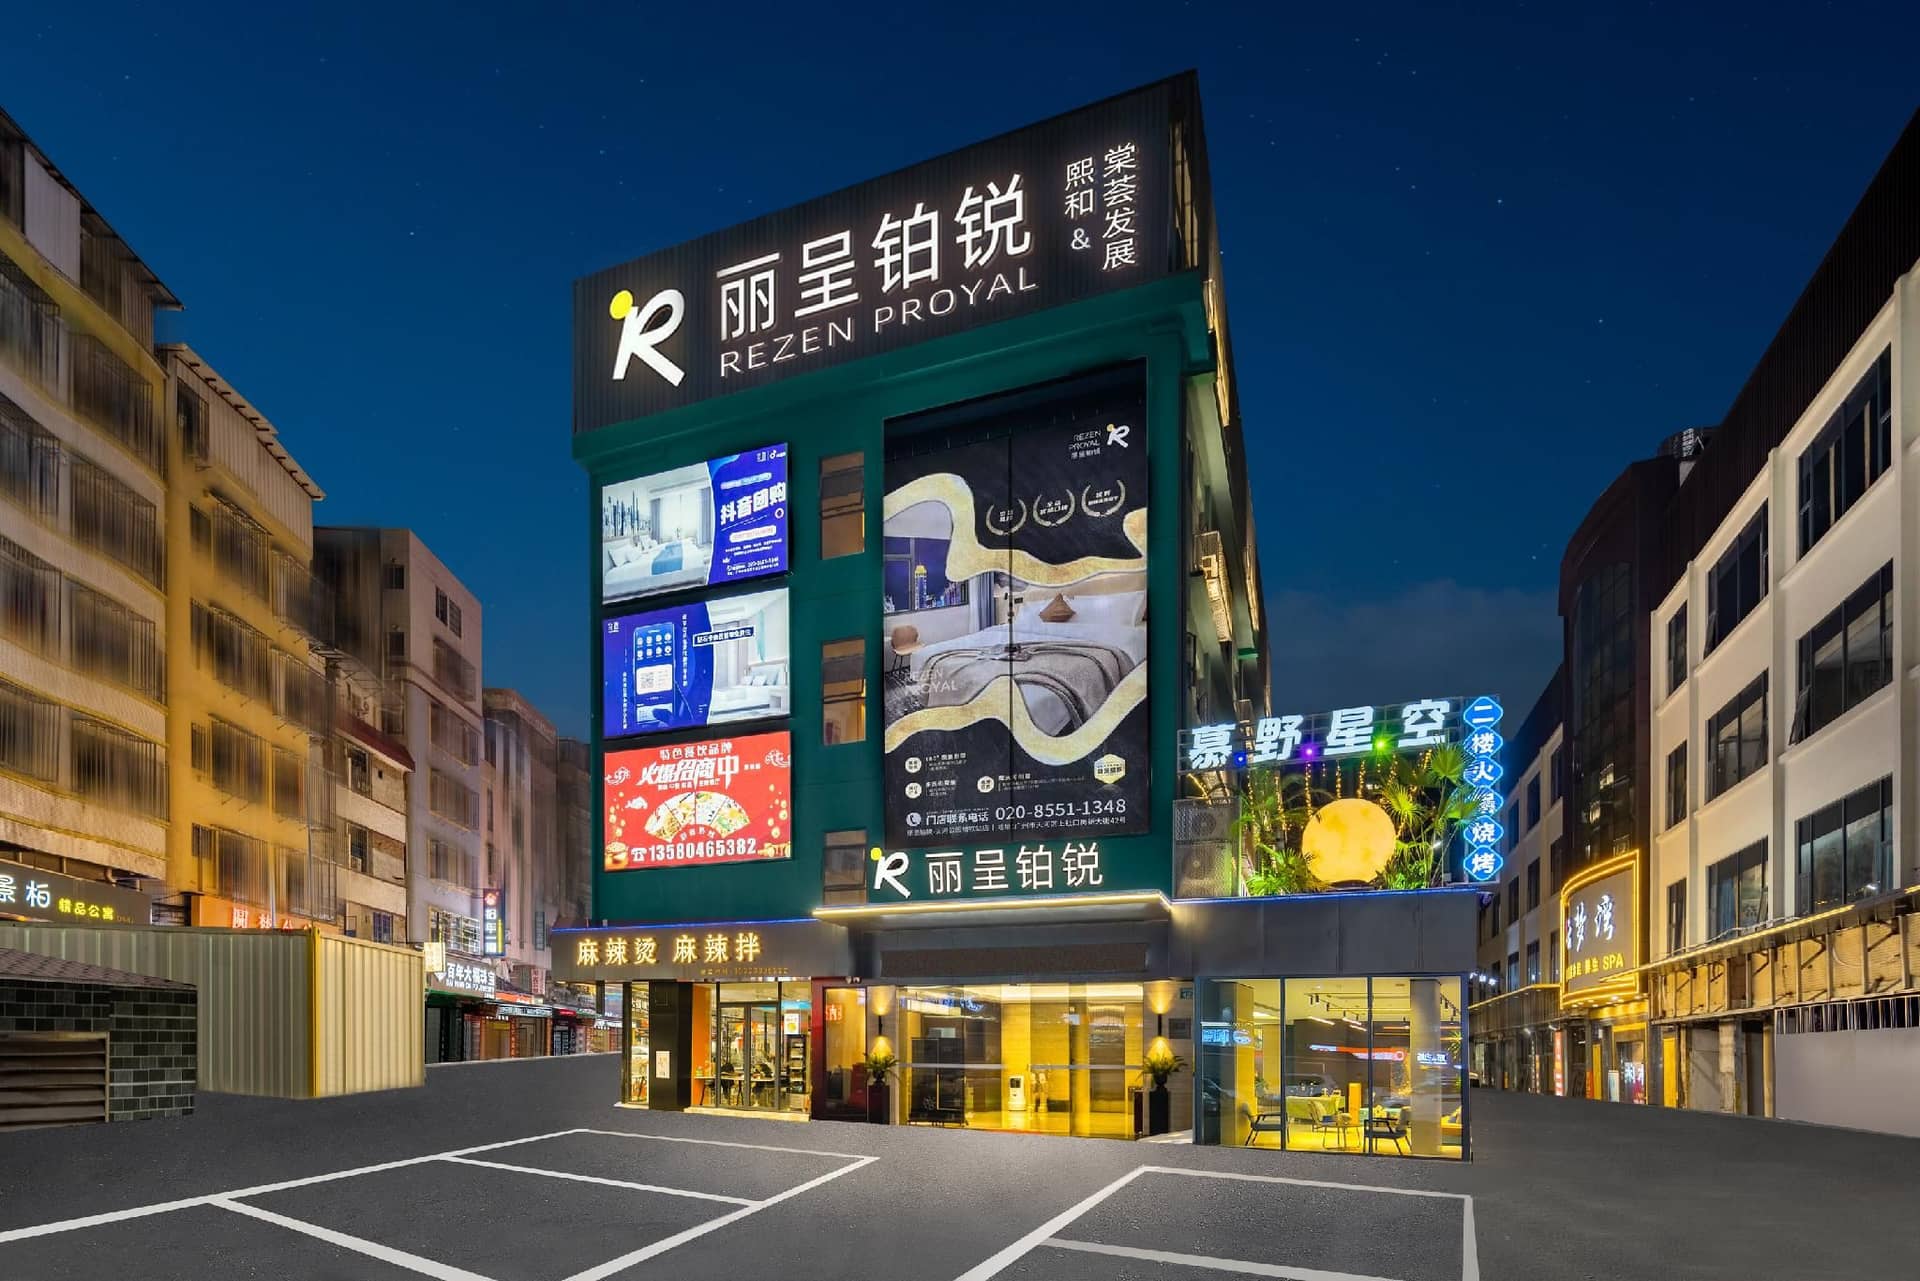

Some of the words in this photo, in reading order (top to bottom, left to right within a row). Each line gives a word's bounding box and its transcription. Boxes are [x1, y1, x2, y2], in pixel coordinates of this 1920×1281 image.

[1102, 142, 1136, 271] 棠荟发展
[716, 173, 1034, 342] 丽呈铂锐
[719, 317, 854, 377] REZEN
[873, 267, 1038, 333] PROYAL
[1073, 430, 1101, 442] REZEN
[926, 811, 989, 826] 门店联系电话
[995, 798, 1127, 821] 020-8551-1348
[649, 837, 757, 862] 13580465382
[925, 842, 1103, 894] 丽呈铂锐
[576, 936, 657, 967] 麻辣烫
[672, 931, 762, 964] 麻辣拌
[1603, 952, 1624, 970] SPA
